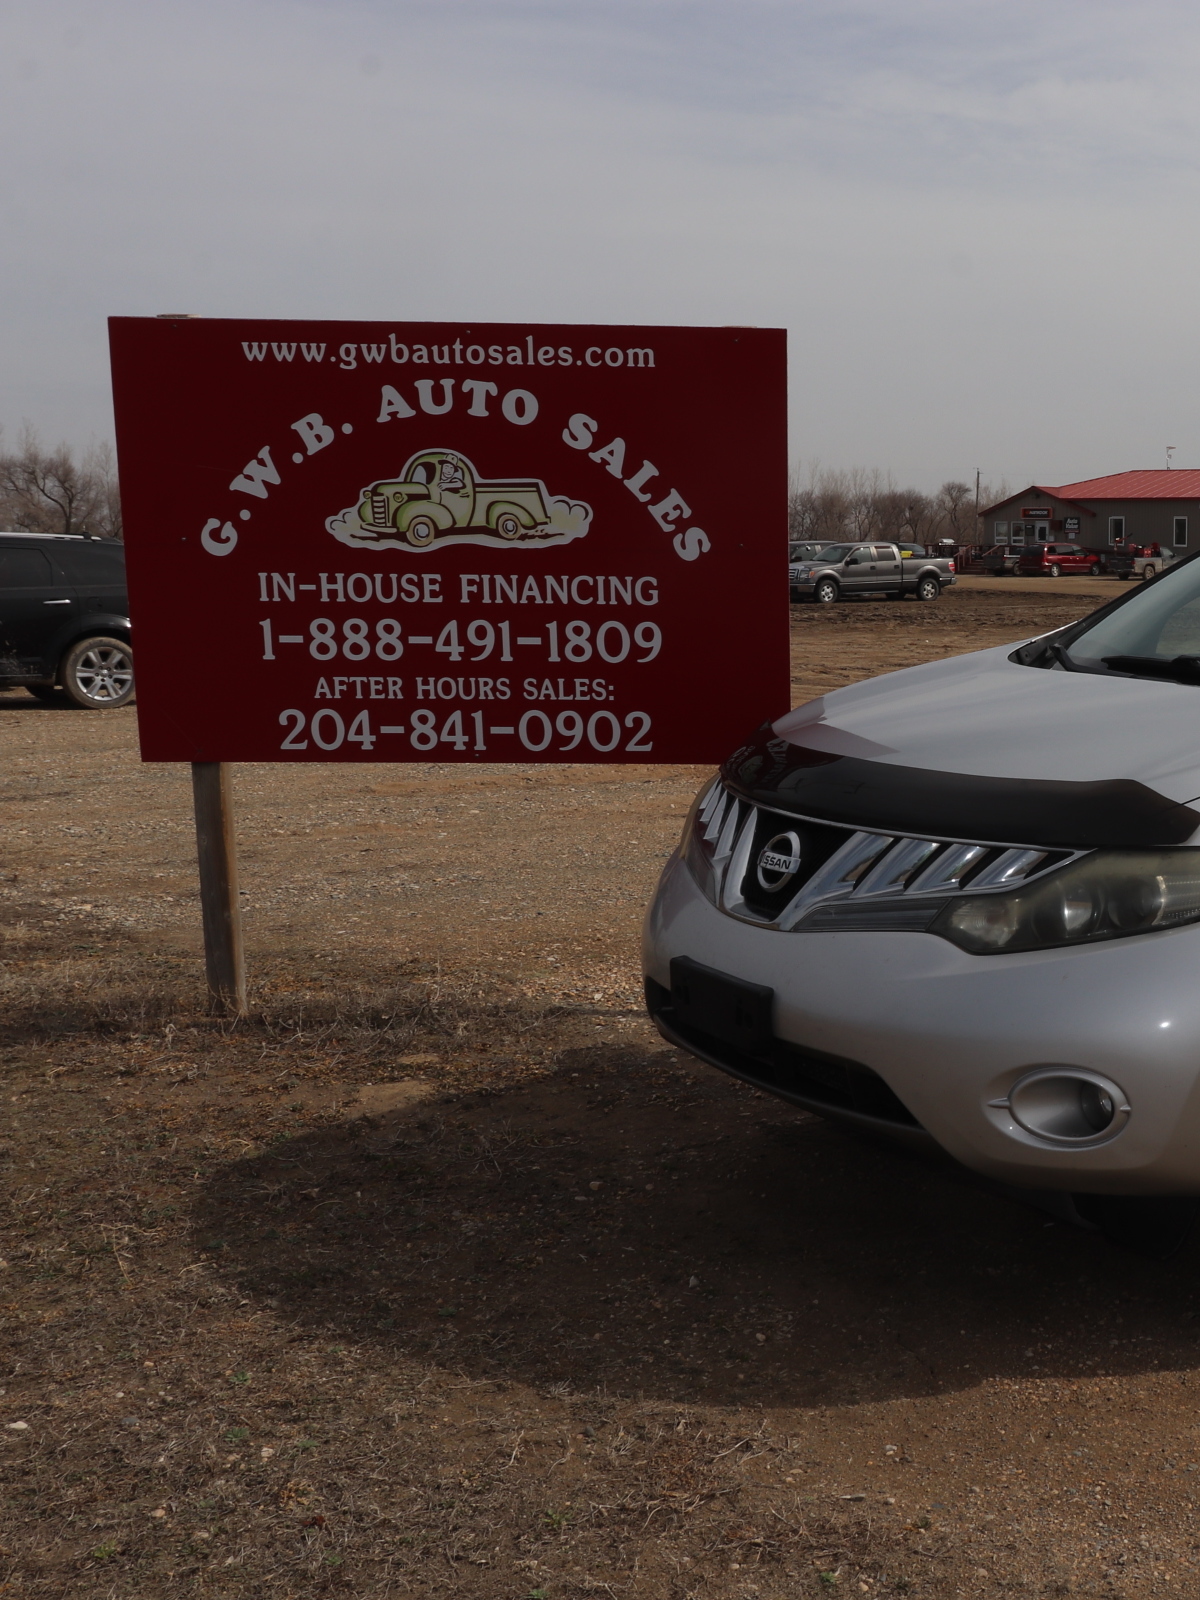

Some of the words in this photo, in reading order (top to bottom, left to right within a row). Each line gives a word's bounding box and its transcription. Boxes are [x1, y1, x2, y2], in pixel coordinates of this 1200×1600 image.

[241, 333, 656, 370] www.gwbautosales.com
[200, 412, 353, 557] G.W.B.
[376, 378, 539, 425] AUTO
[561, 412, 712, 562] SALES
[258, 573, 443, 603] IN-HOUSE
[460, 574, 660, 606] FINANCING
[259, 617, 663, 664] 1-888-491-1809
[314, 676, 404, 700] AFTER
[415, 677, 511, 701] HOURS
[523, 678, 615, 701] SALES:
[278, 708, 653, 752] 204-841-0902
[761, 855, 792, 870] SSAN
